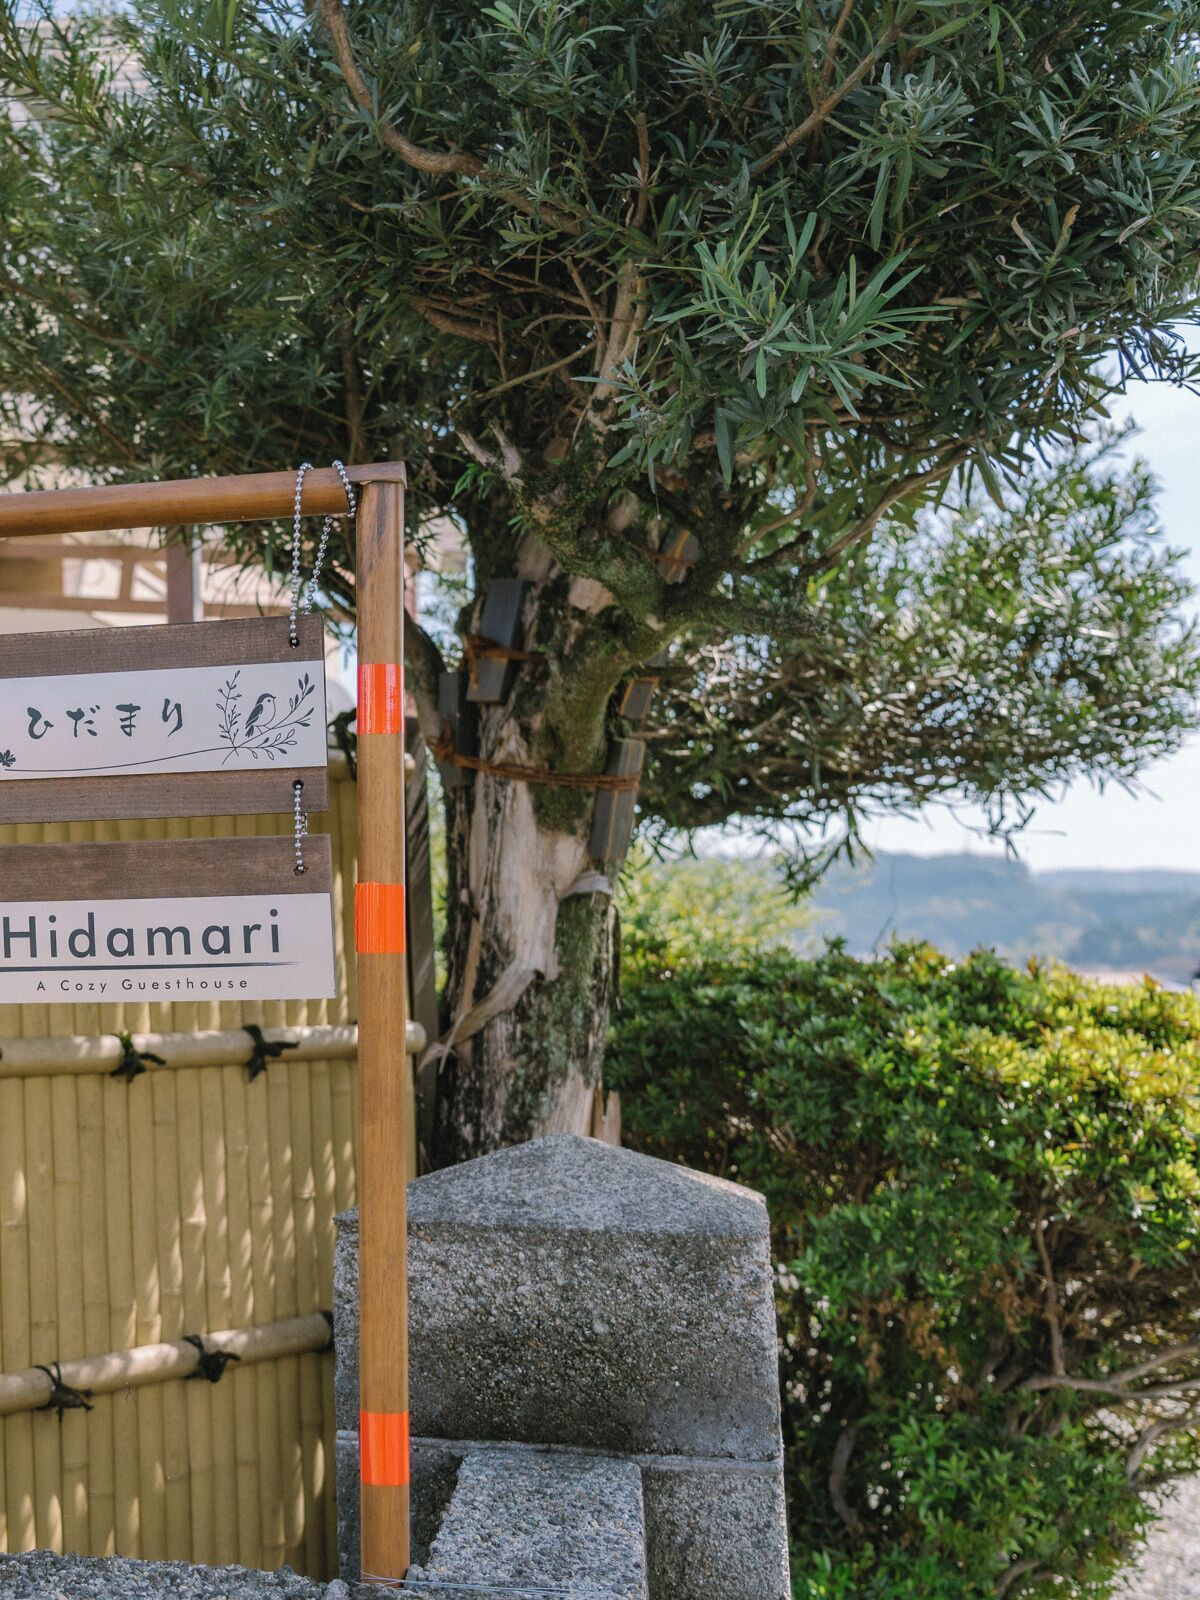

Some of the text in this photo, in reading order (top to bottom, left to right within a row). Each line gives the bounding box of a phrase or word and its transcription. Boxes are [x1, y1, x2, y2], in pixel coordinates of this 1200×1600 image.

[26, 698, 184, 740] ひだまり
[2, 908, 280, 959] Hidamari
[36, 977, 248, 994] A Cozy Guesthouse
